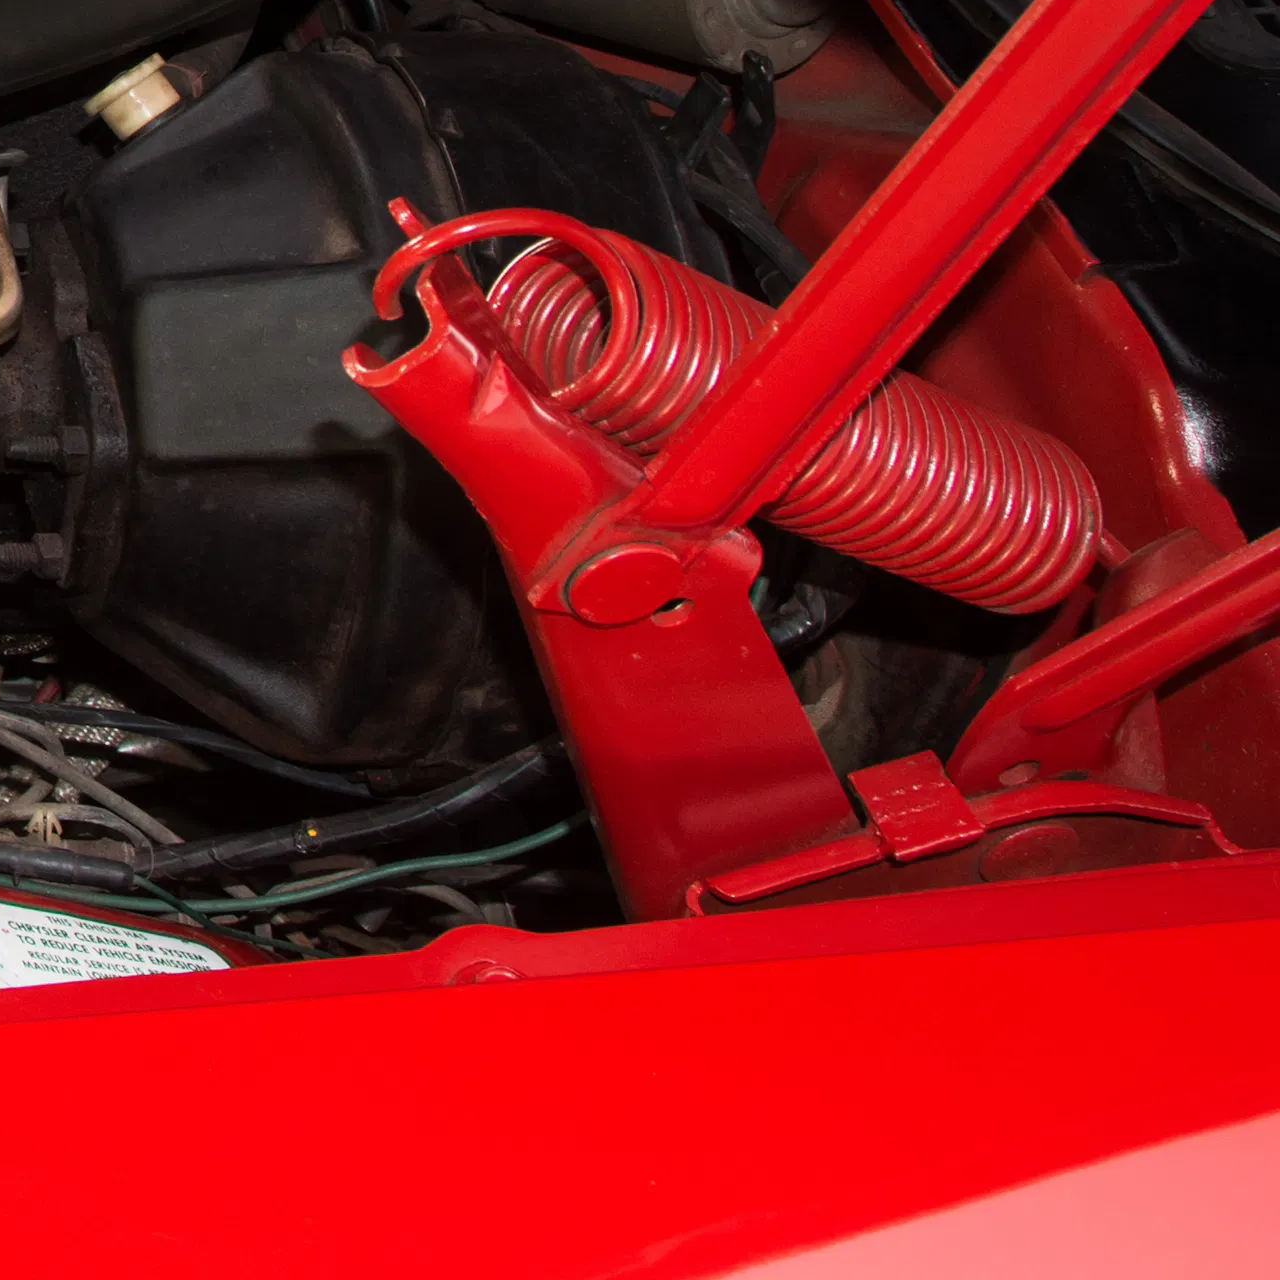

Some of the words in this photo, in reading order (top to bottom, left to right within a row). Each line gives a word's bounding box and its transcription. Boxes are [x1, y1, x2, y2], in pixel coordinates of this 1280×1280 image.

[45, 915, 73, 928] THIS
[73, 920, 122, 936] VEHICLE
[8, 920, 71, 939] CHRYSLER
[74, 931, 131, 949] CLEANER
[135, 942, 156, 954] AIR
[158, 946, 208, 964] SYSTEM
[16, 933, 37, 946] TO
[39, 937, 91, 954] REDUCE
[92, 946, 146, 964] VEHICLE
[21, 959, 83, 978] MAINTAIN
[27, 950, 81, 966] REGULAR
[83, 958, 131, 974] SERVICE
